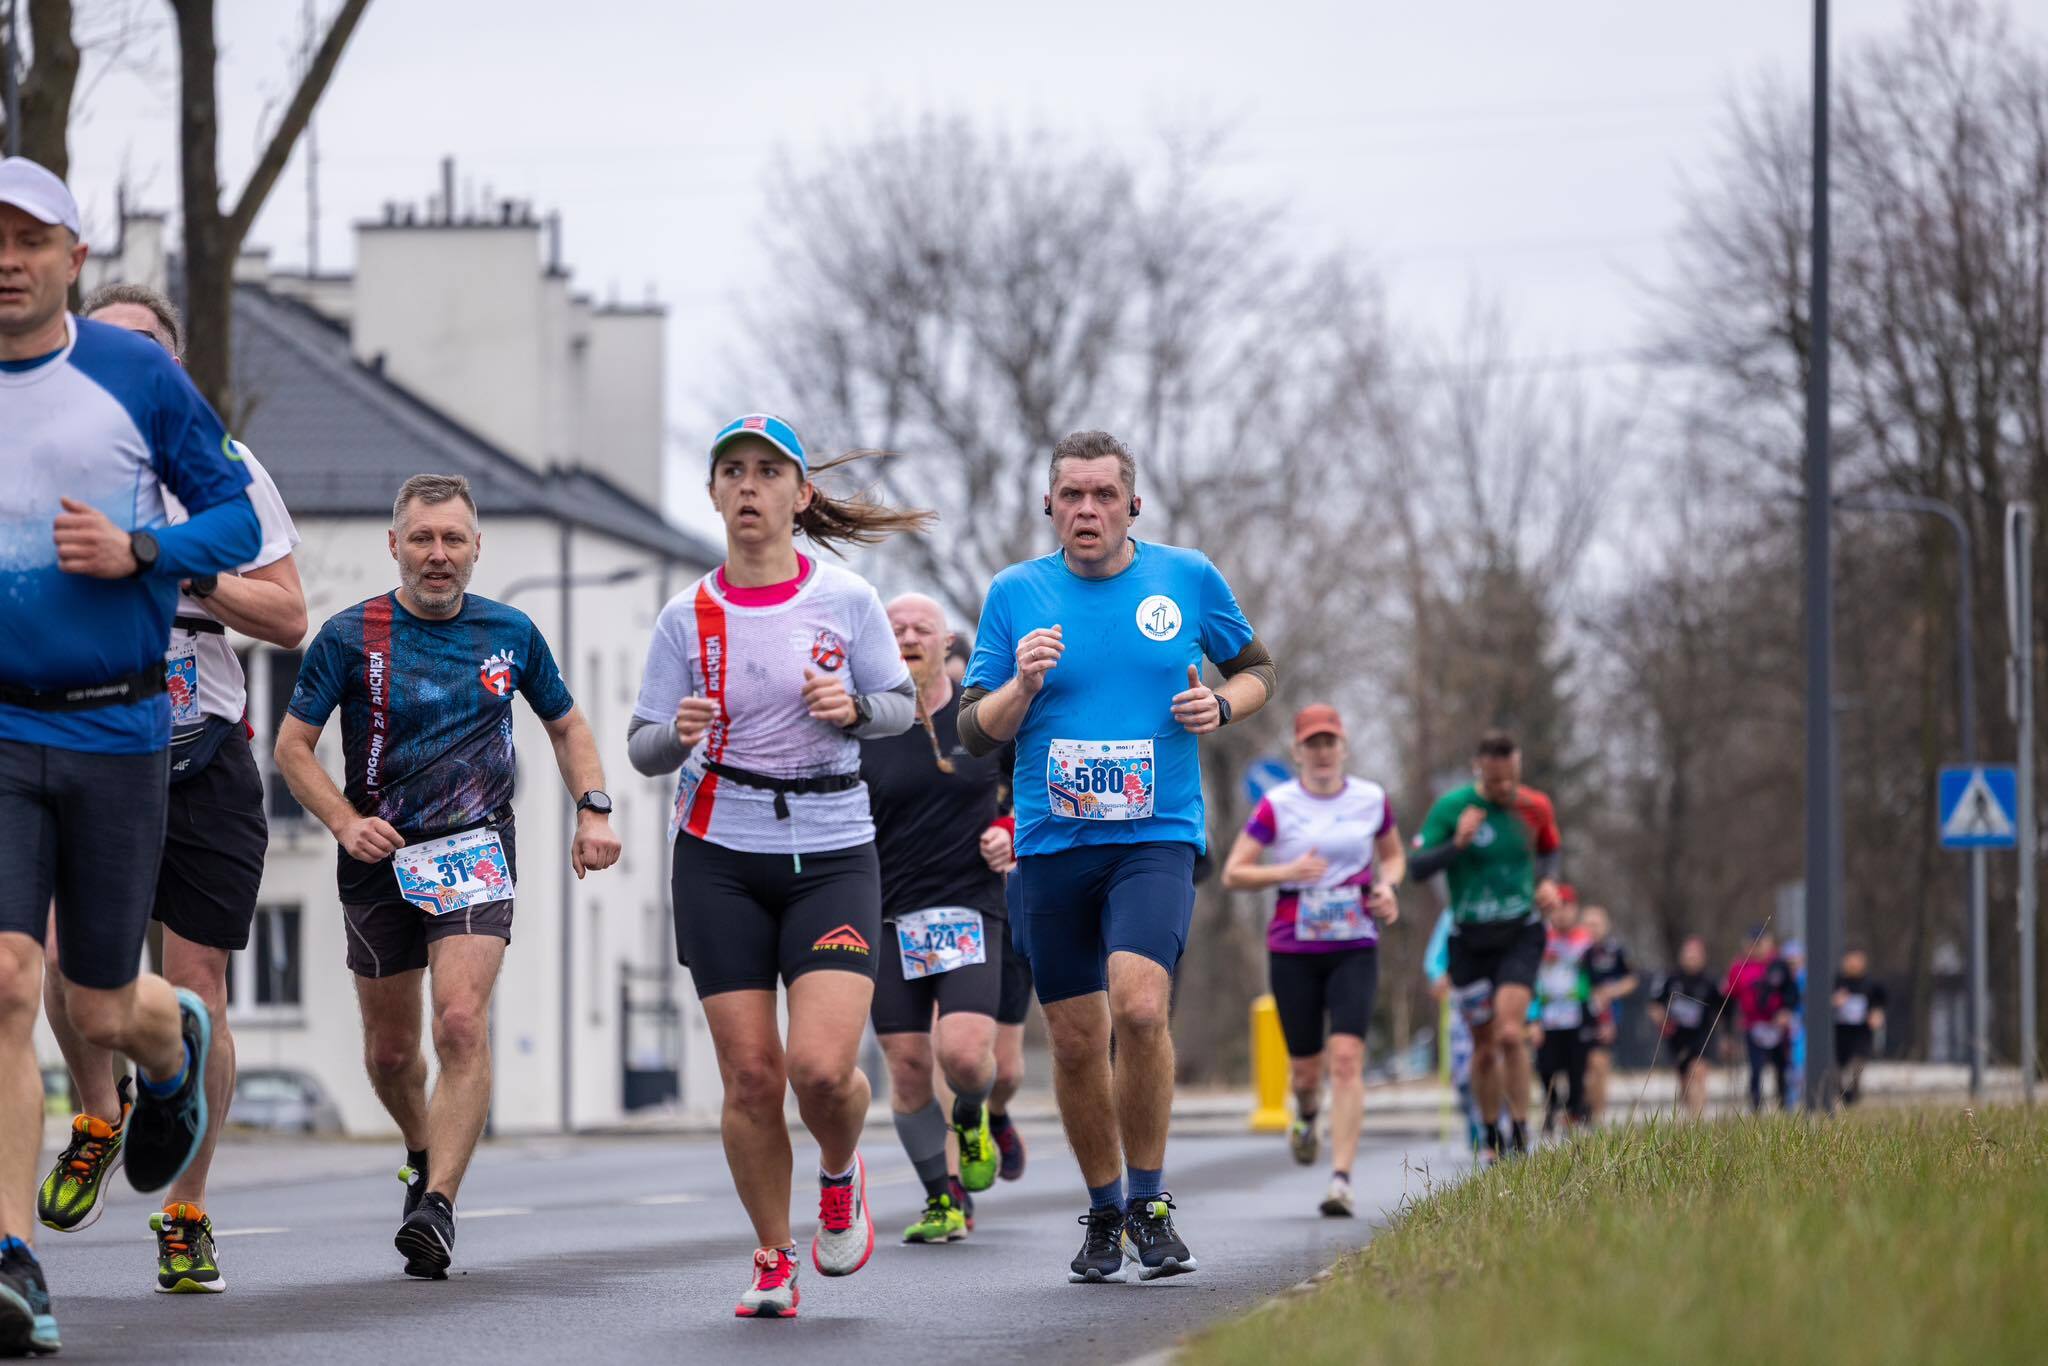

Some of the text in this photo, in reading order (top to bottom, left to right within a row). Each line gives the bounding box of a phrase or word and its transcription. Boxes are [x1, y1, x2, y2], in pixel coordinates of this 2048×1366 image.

[369, 651, 386, 705] DUCHEM
[374, 712, 385, 729] ZA
[172, 758, 191, 771] 4F
[367, 734, 384, 787] POGONI
[1075, 767, 1124, 793] 580
[438, 859, 469, 887] 31
[843, 944, 869, 955] TRAIL
[924, 930, 957, 952] 424
